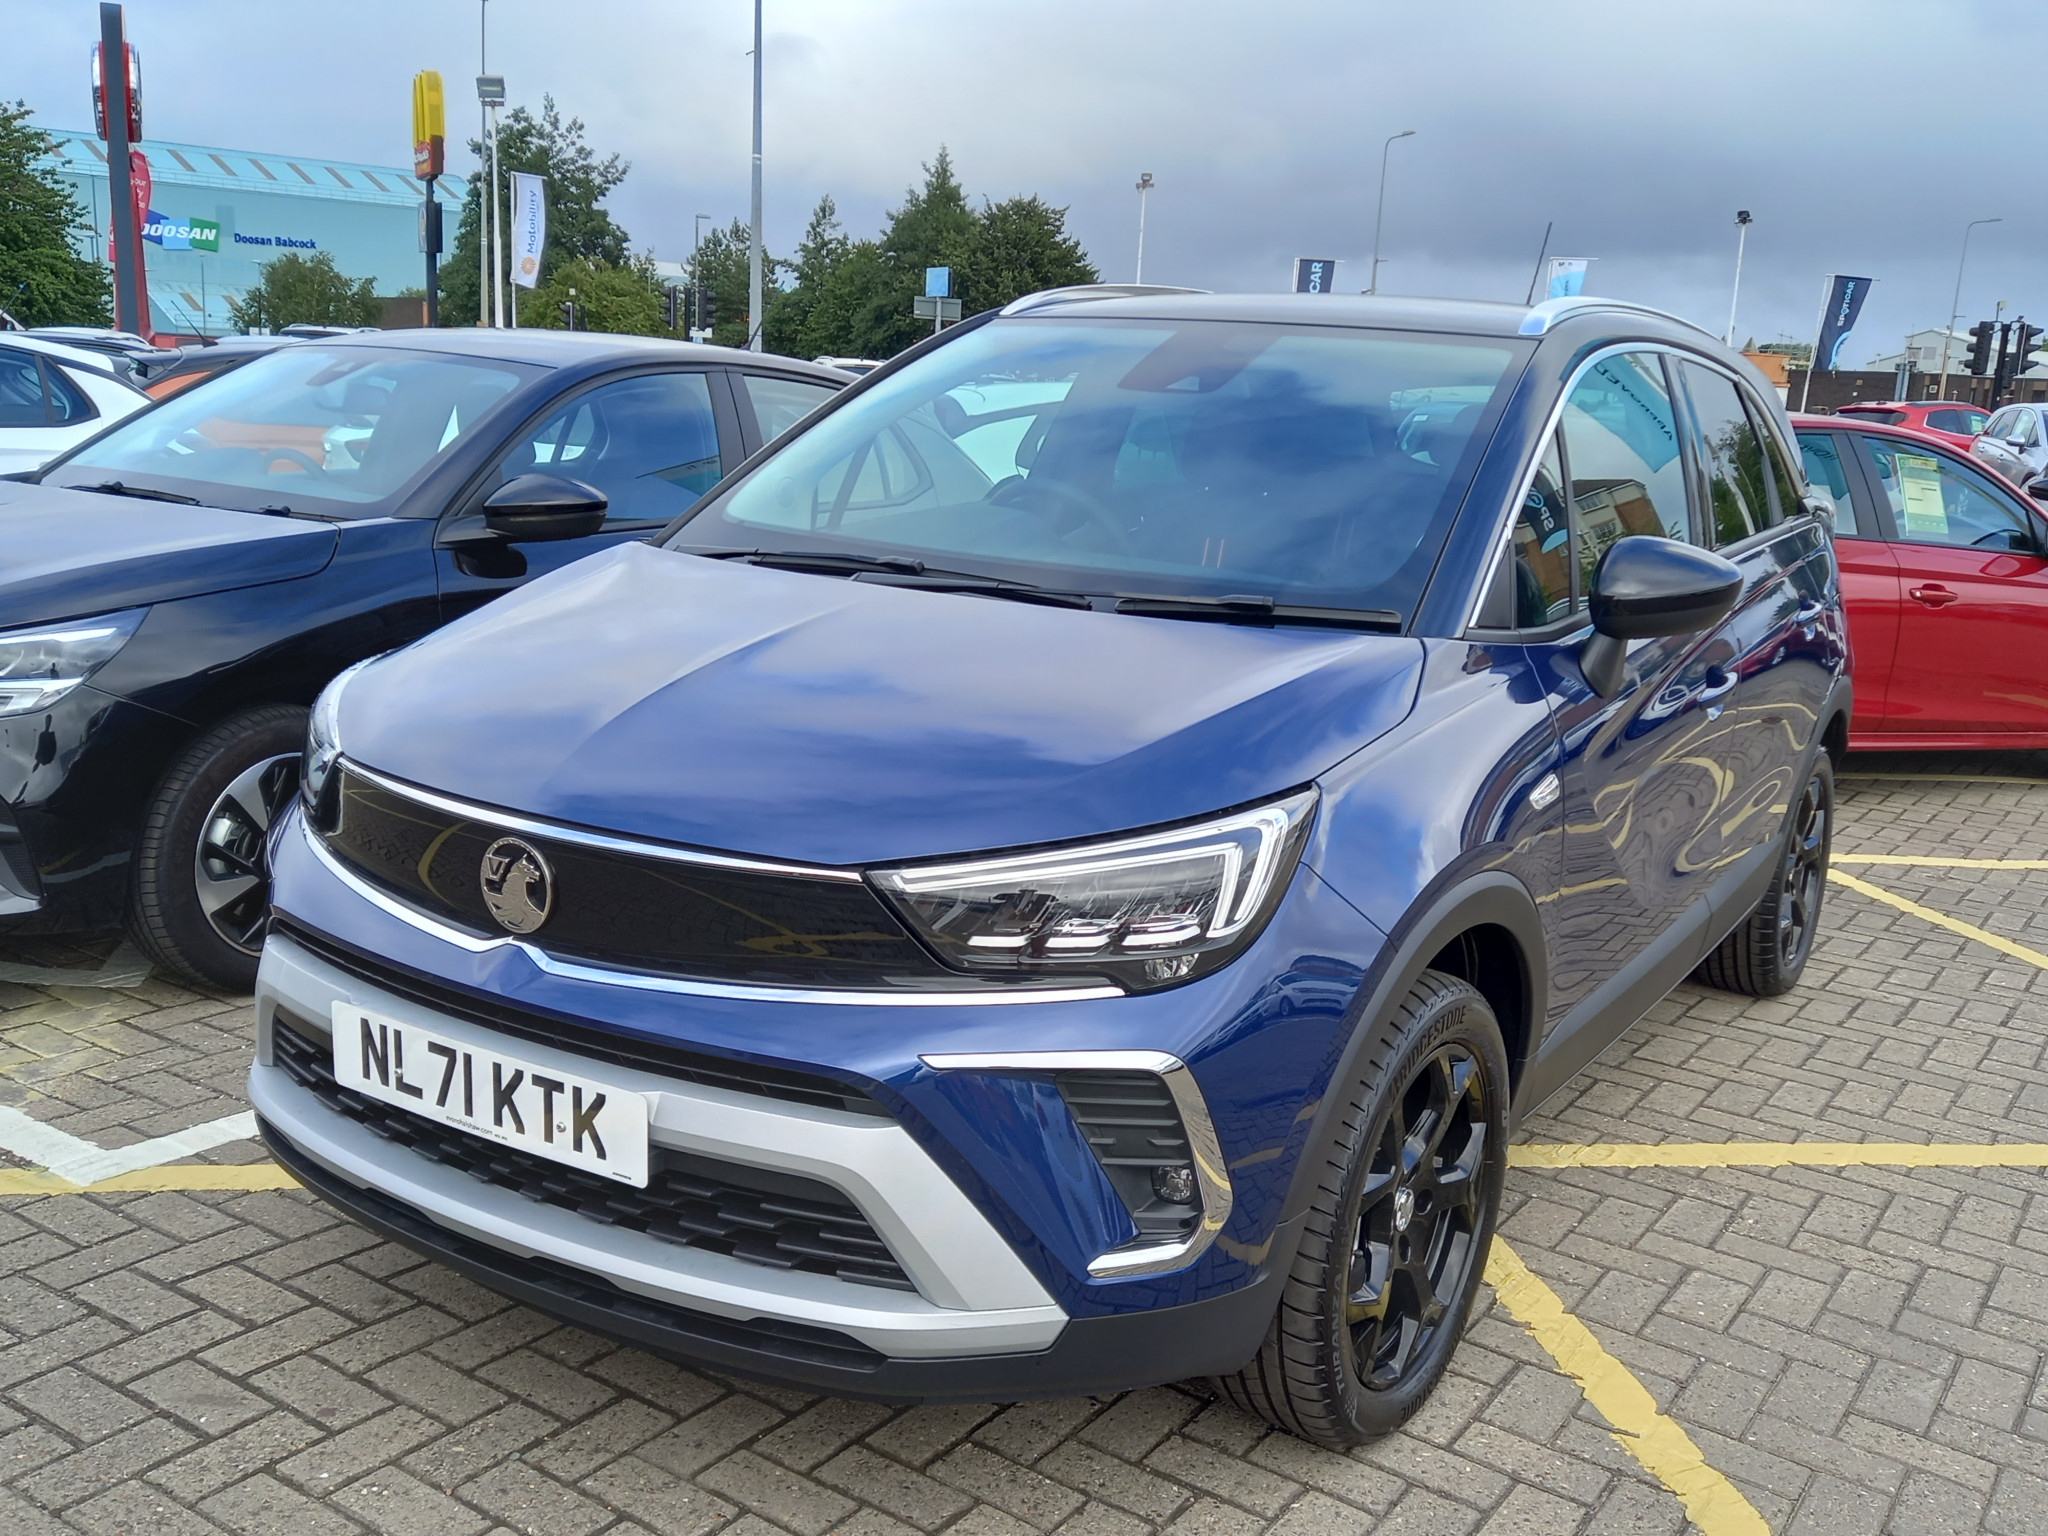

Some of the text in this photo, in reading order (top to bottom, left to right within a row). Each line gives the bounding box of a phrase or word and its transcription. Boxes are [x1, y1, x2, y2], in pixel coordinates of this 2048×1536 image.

[234, 233, 317, 249] Doosan Babcock
[526, 190, 538, 253] Motability
[360, 1017, 607, 1161] NL71 KTK
[1331, 1272, 1346, 1396] TURANZA
